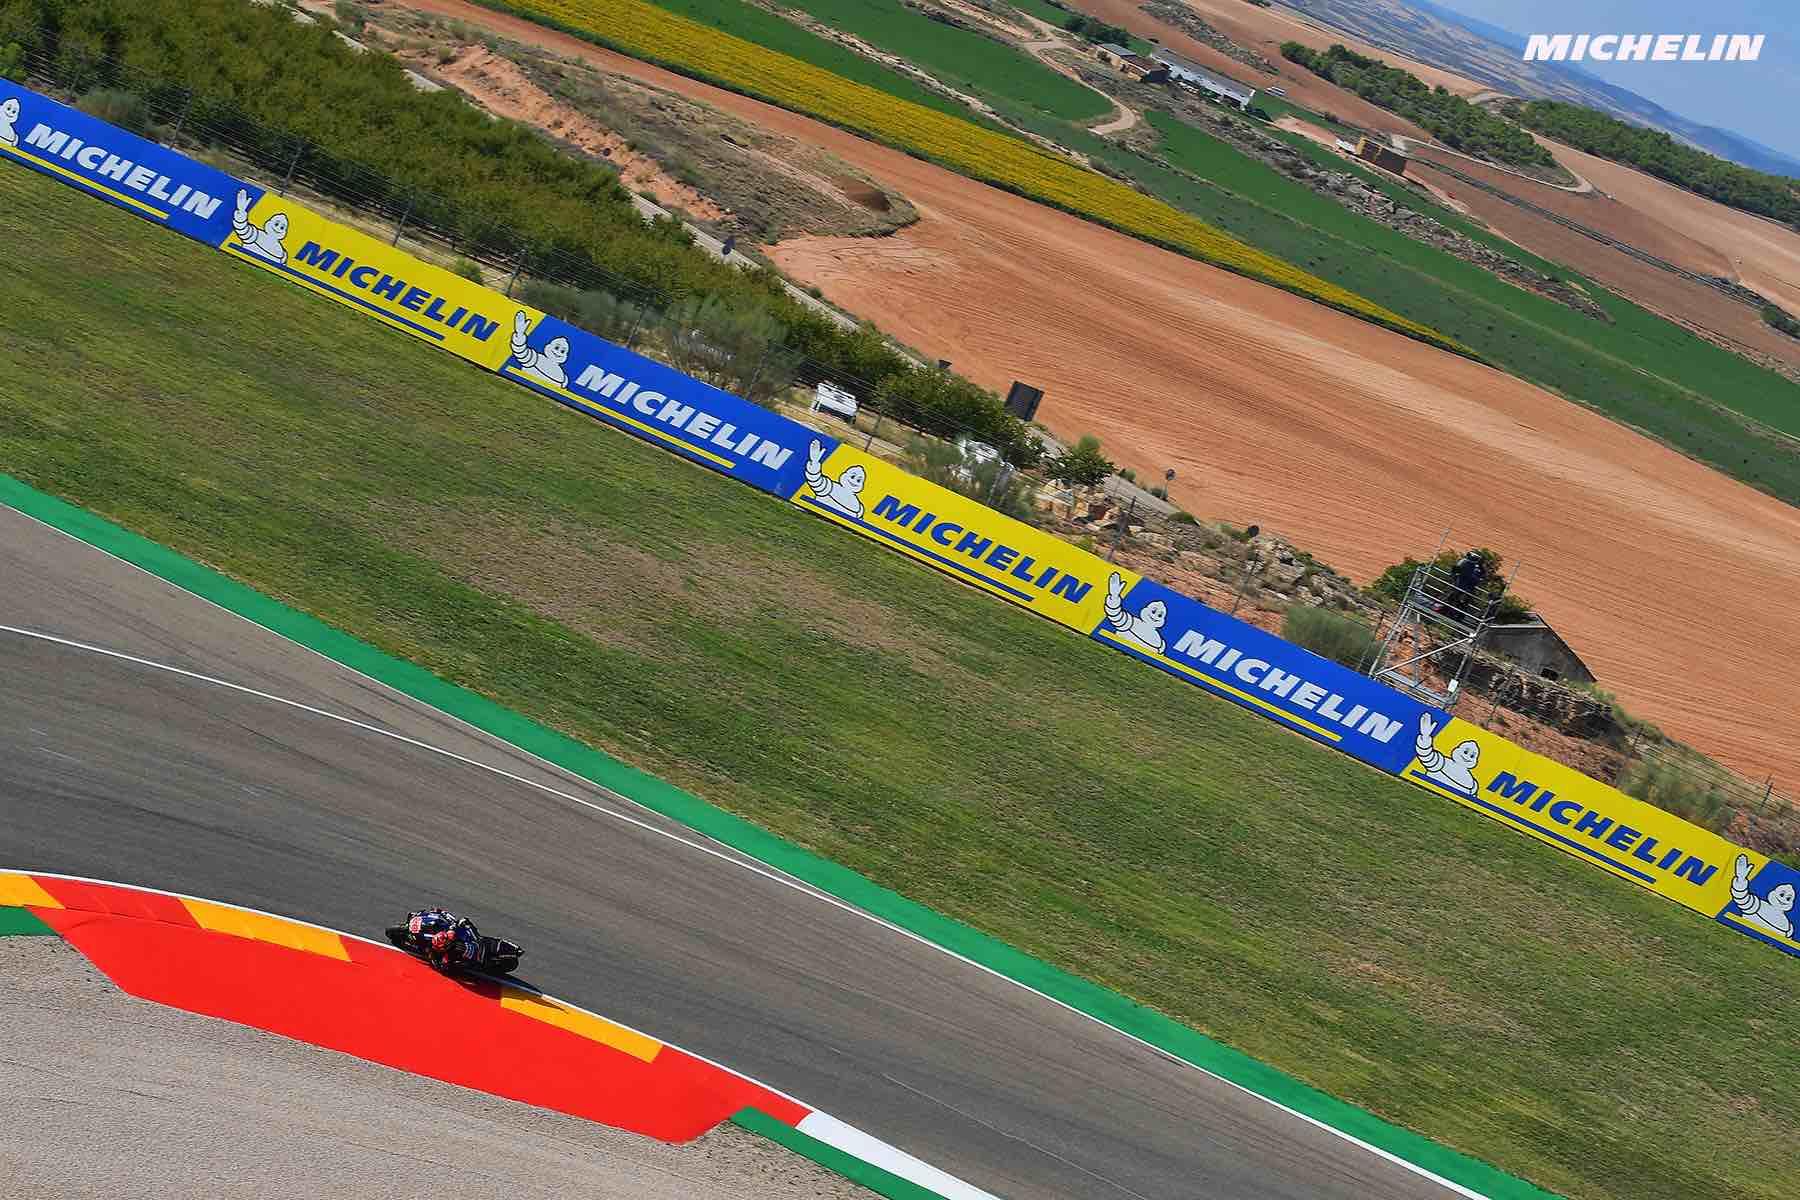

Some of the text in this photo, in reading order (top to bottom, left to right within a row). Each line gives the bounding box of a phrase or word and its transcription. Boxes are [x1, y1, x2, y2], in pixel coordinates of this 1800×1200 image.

[24, 122, 223, 220] MICHELIN
[295, 240, 500, 342] MICHELIN
[574, 364, 794, 471] MICHELIN
[872, 494, 1092, 603] MICHELIN
[1172, 629, 1404, 743] MICHELIN
[1486, 771, 1719, 886] MICHELIN
